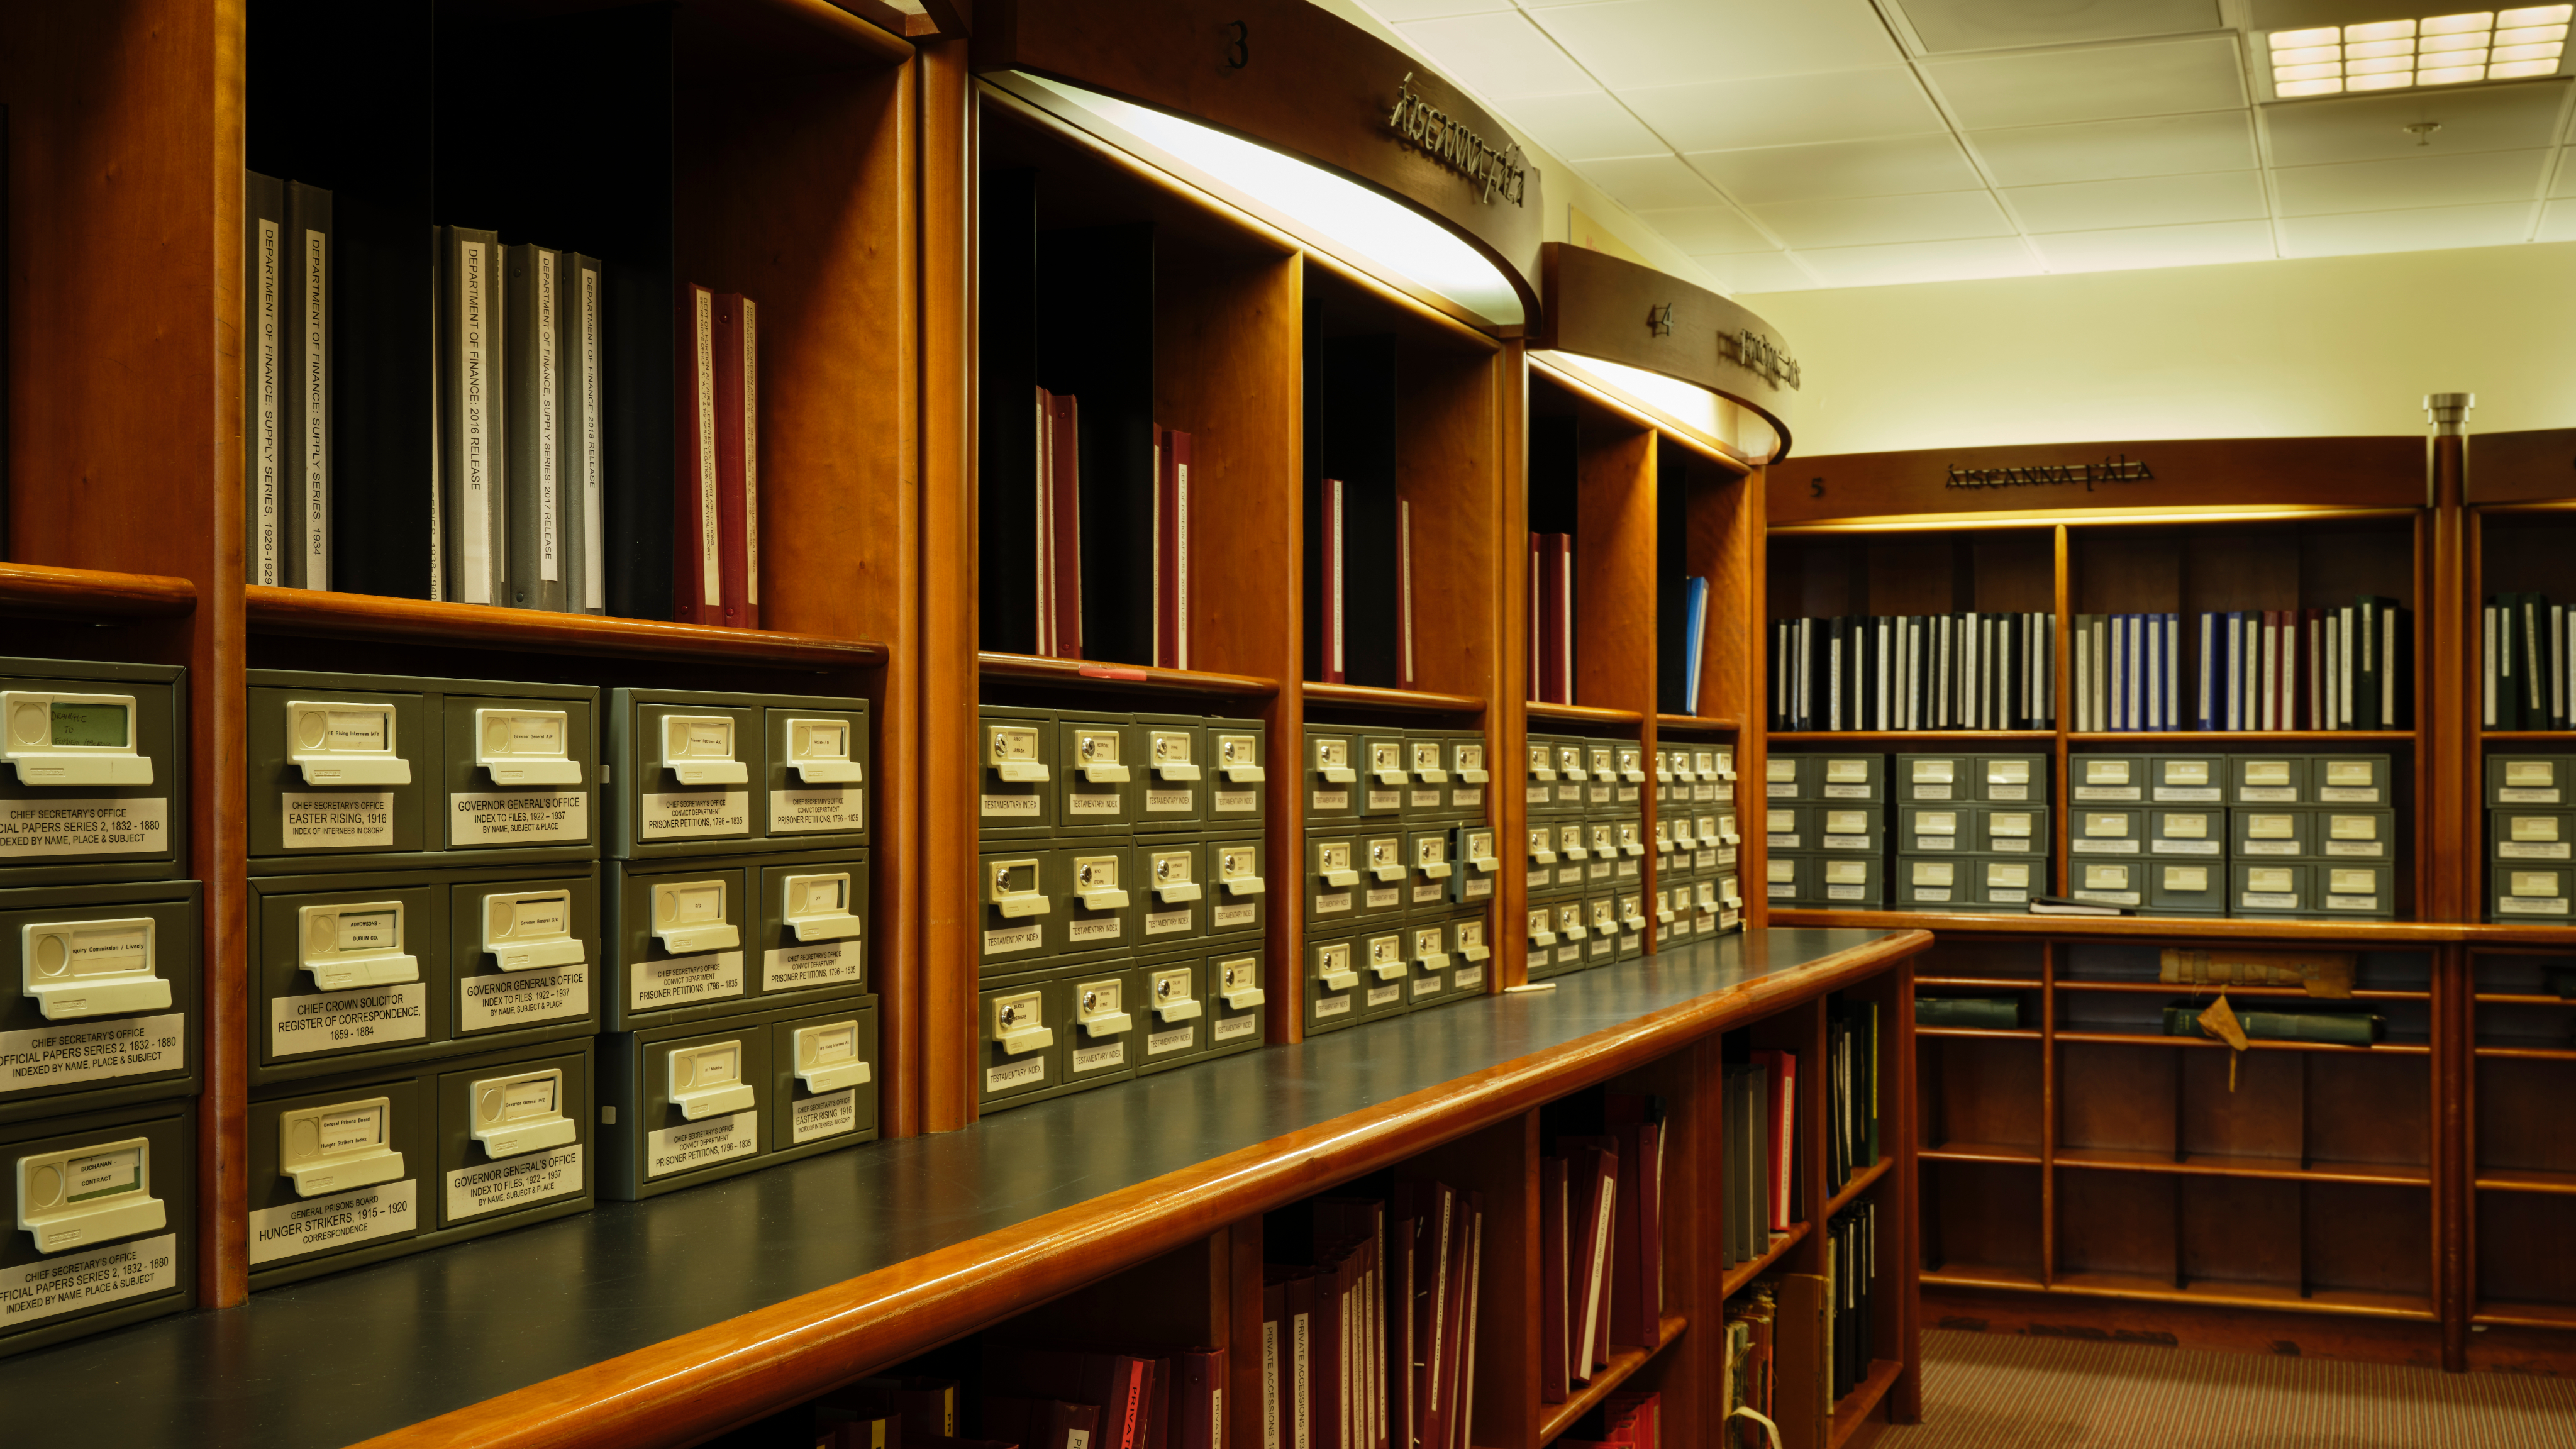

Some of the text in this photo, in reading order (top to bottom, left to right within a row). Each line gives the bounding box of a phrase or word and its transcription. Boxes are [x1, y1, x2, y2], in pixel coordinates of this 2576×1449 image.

[1228, 19, 1248, 69] 3
[704, 321, 708, 332] OF
[1662, 303, 1674, 336] 4
[265, 324, 273, 341] OF
[313, 332, 319, 350] OF
[543, 332, 550, 346] OF
[469, 249, 480, 490] DEPARTMENT OF FINANCE: 2016 RELEASE
[264, 466, 272, 516] SERIES,
[1810, 477, 1823, 497] 5
[313, 473, 321, 522] SERIES,
[458, 797, 579, 811] GOVERNOR GENERAL'S OFFICE
[984, 800, 1037, 809] TESTAMENTARY INDEX
[289, 814, 387, 825] EASTER RISING, 1916
[475, 814, 496, 823] INDEX
[497, 814, 506, 822] TO
[509, 813, 528, 822] FILES,
[531, 812, 544, 821] 1922
[552, 811, 565, 819] 1937
[649, 819, 679, 829] PRISONER
[680, 818, 711, 827] PETITIONS,
[713, 818, 724, 826] 1796
[492, 825, 509, 833] NAME,
[511, 824, 535, 832] SUBJECT
[1072, 924, 1118, 935] TESTAMENTARY INDEX
[298, 994, 403, 1015] CHIEF CROWN SOLICITOR
[279, 1006, 420, 1033] REGISTER OF CORRESPONDENCE,
[32, 1028, 144, 1048] CHIEF SECRETARY'S OFFICE
[331, 1029, 348, 1040] 1859
[356, 1026, 374, 1037] 1884
[1150, 1033, 1191, 1048] TESTAMENTARY INDEX
[43, 1048, 81, 1061] PAPERS
[84, 1043, 117, 1056] SERIES
[119, 1043, 127, 1053] 2,
[130, 1040, 149, 1051] 1832
[157, 1037, 176, 1048] 1880
[13, 1052, 162, 1077] INDEXED BY NAME, PLACE & SUBJECT
[796, 1106, 852, 1125] EASTER RISING, 1916
[81, 1161, 112, 1172] BUCHANAN
[81, 1175, 111, 1186] CONTRACT
[291, 1195, 379, 1220] GENERAL PRISONS BOARD
[260, 1223, 302, 1241] HUNGER
[305, 1212, 355, 1233] STRIKERS,
[358, 1207, 377, 1221] 1915
[388, 1201, 407, 1215] 1920
[303, 1223, 367, 1244] CORRESPONDENCE
